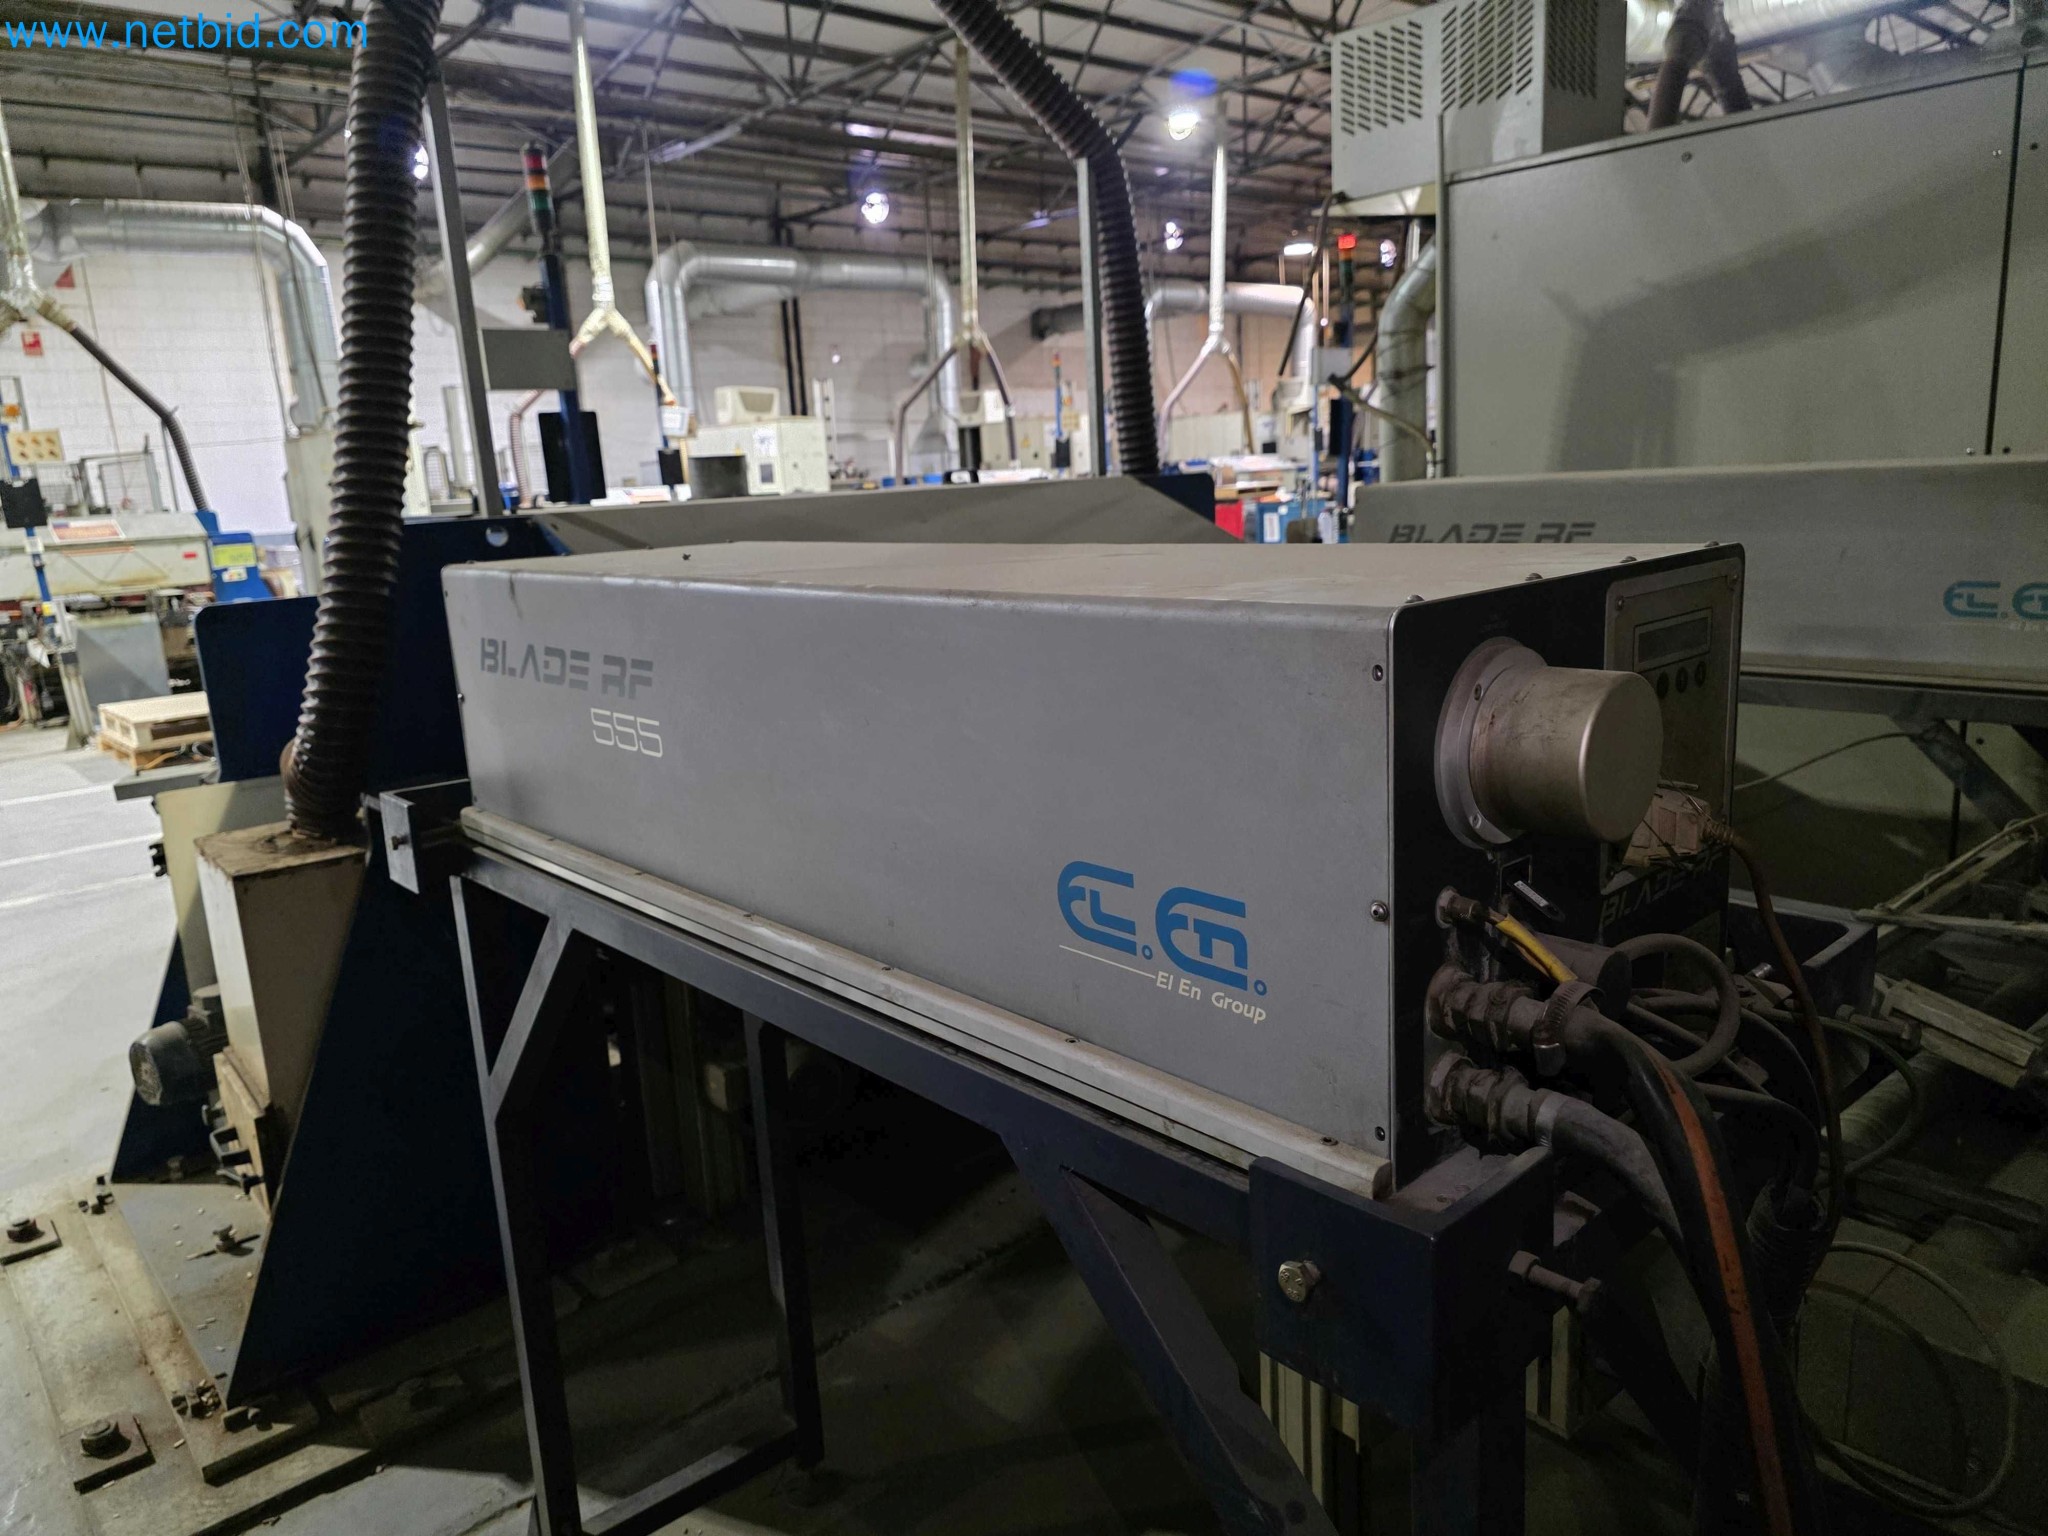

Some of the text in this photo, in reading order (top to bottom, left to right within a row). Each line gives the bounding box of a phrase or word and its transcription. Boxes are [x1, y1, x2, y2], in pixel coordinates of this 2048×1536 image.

[1389, 522, 1596, 543] BLADE RF
[480, 636, 653, 699] BLADE RF
[590, 707, 663, 758] 555
[1178, 977, 1202, 1001] En
[1211, 991, 1267, 1025] Group
